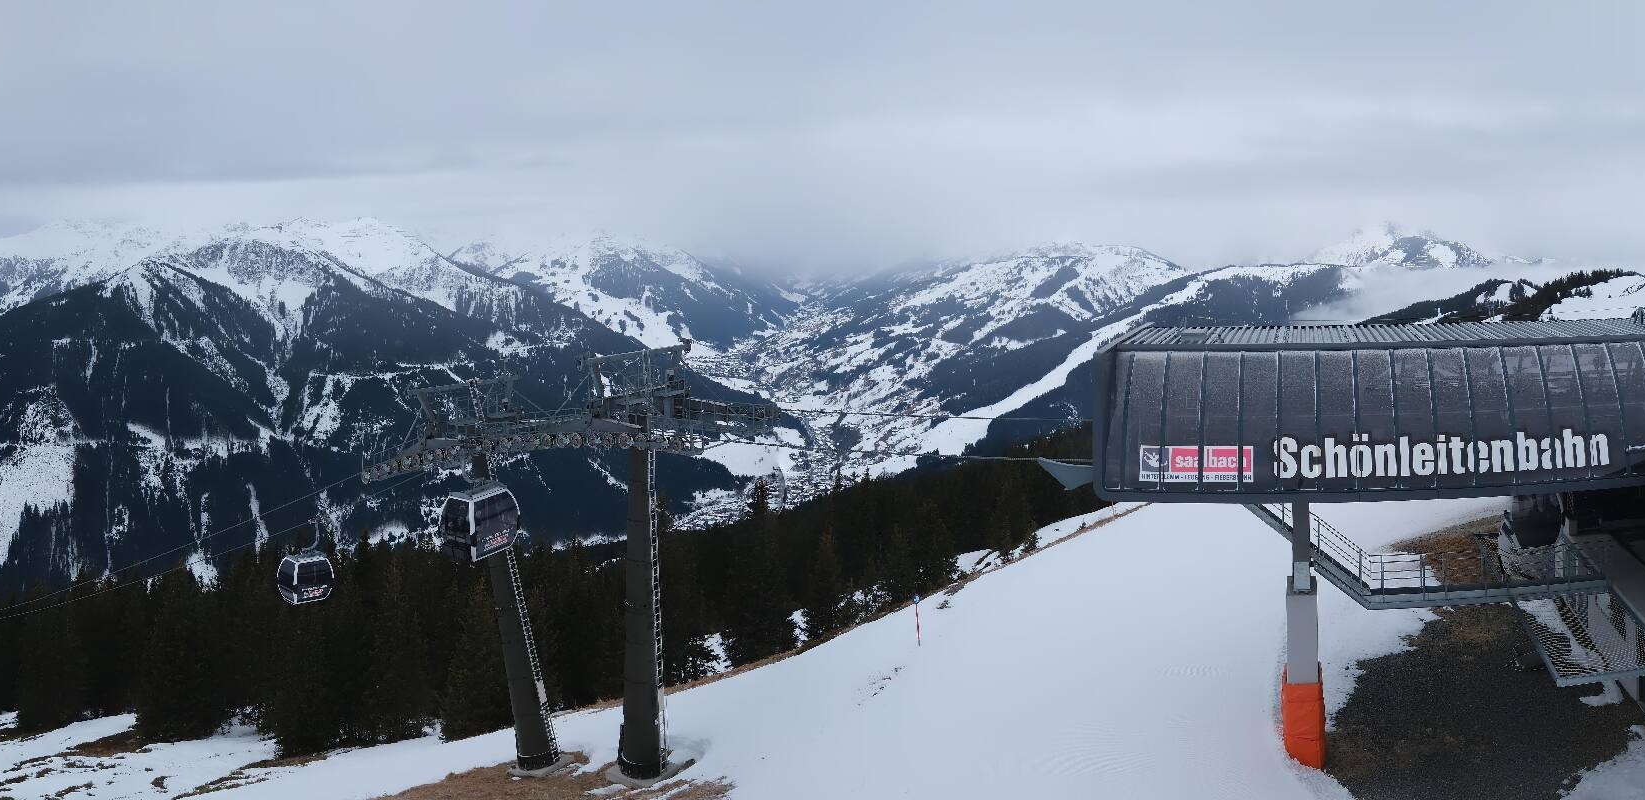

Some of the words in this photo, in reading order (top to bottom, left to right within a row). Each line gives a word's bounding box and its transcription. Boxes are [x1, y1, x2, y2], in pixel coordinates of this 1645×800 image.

[1273, 428, 1610, 479] Schönleitenbahn
[1141, 473, 1180, 481] HINTERLEMM
[1184, 473, 1210, 481] LEOGG
[1214, 473, 1252, 481] FIEBERBNN
